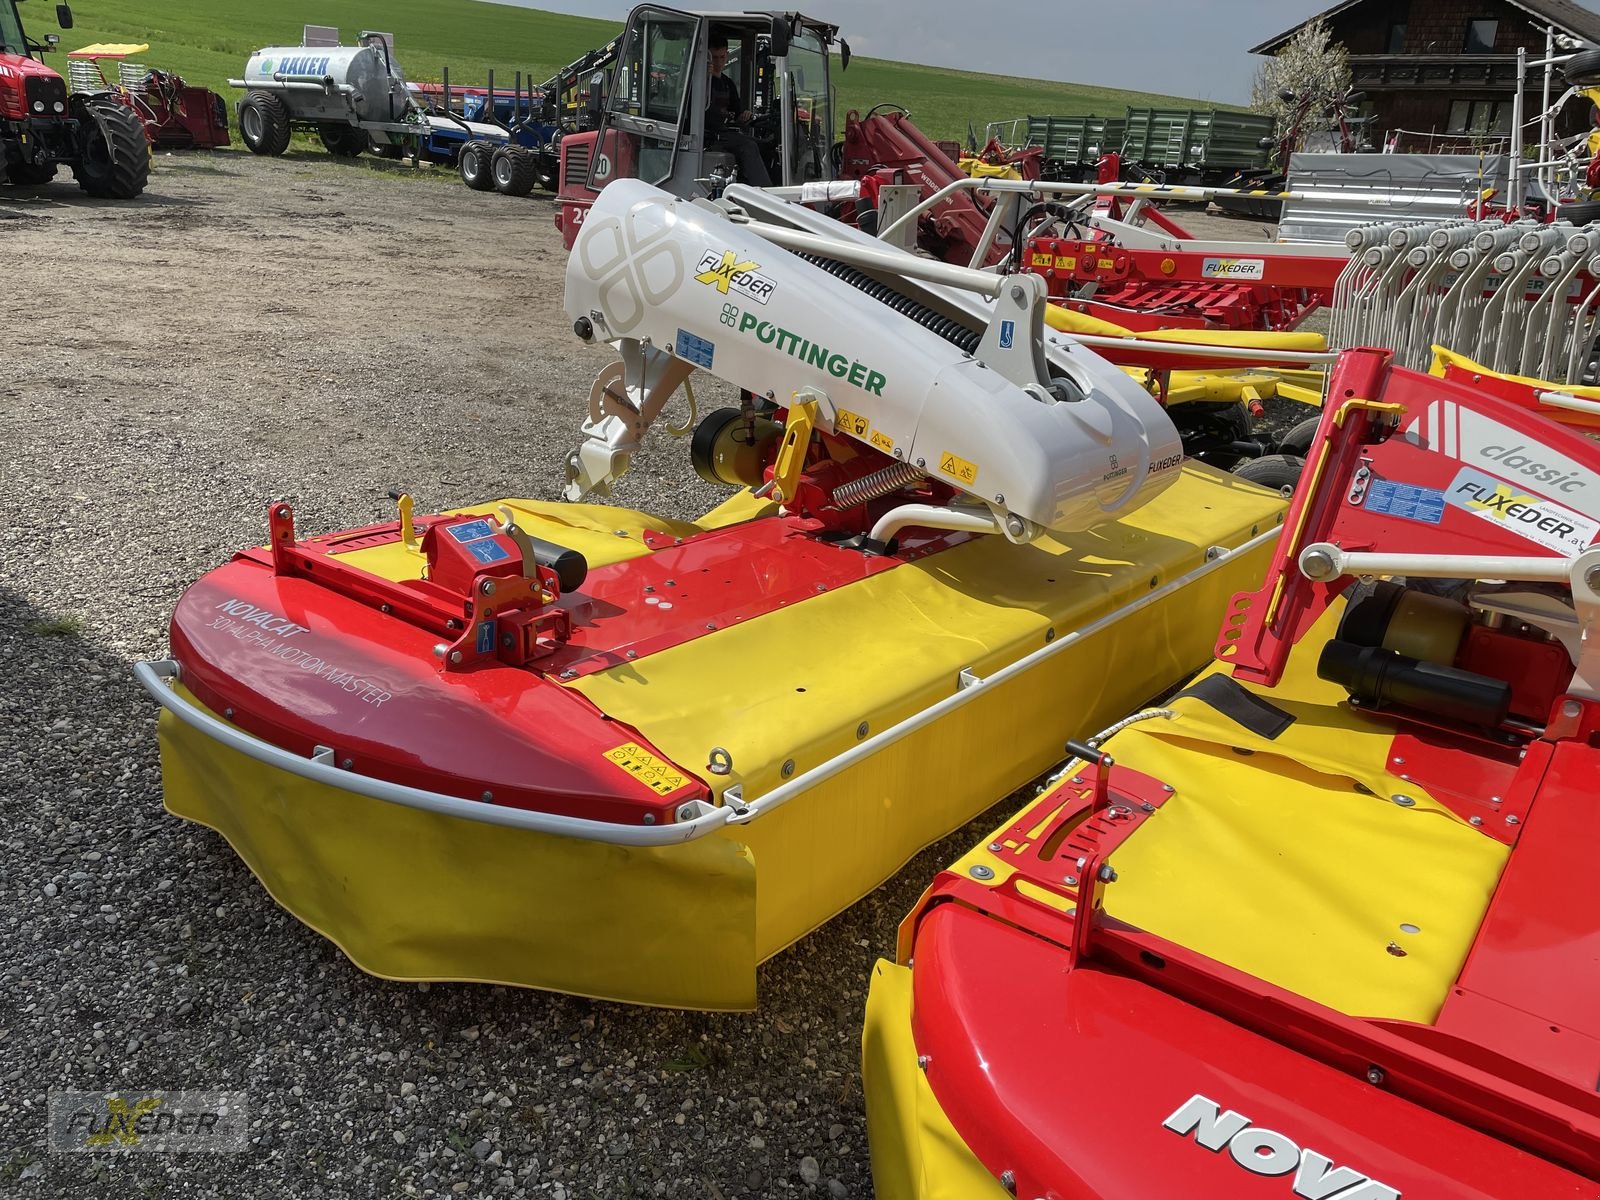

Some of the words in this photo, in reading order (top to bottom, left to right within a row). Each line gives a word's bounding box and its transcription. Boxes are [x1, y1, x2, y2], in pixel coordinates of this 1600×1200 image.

[278, 57, 330, 76] BAUER
[699, 255, 774, 298] FLIXEDER
[1479, 445, 1587, 493] classic
[215, 598, 311, 639] NOVACAT
[231, 624, 276, 650] ALPHA
[270, 643, 330, 675] MOTION
[322, 668, 392, 708] MASTER
